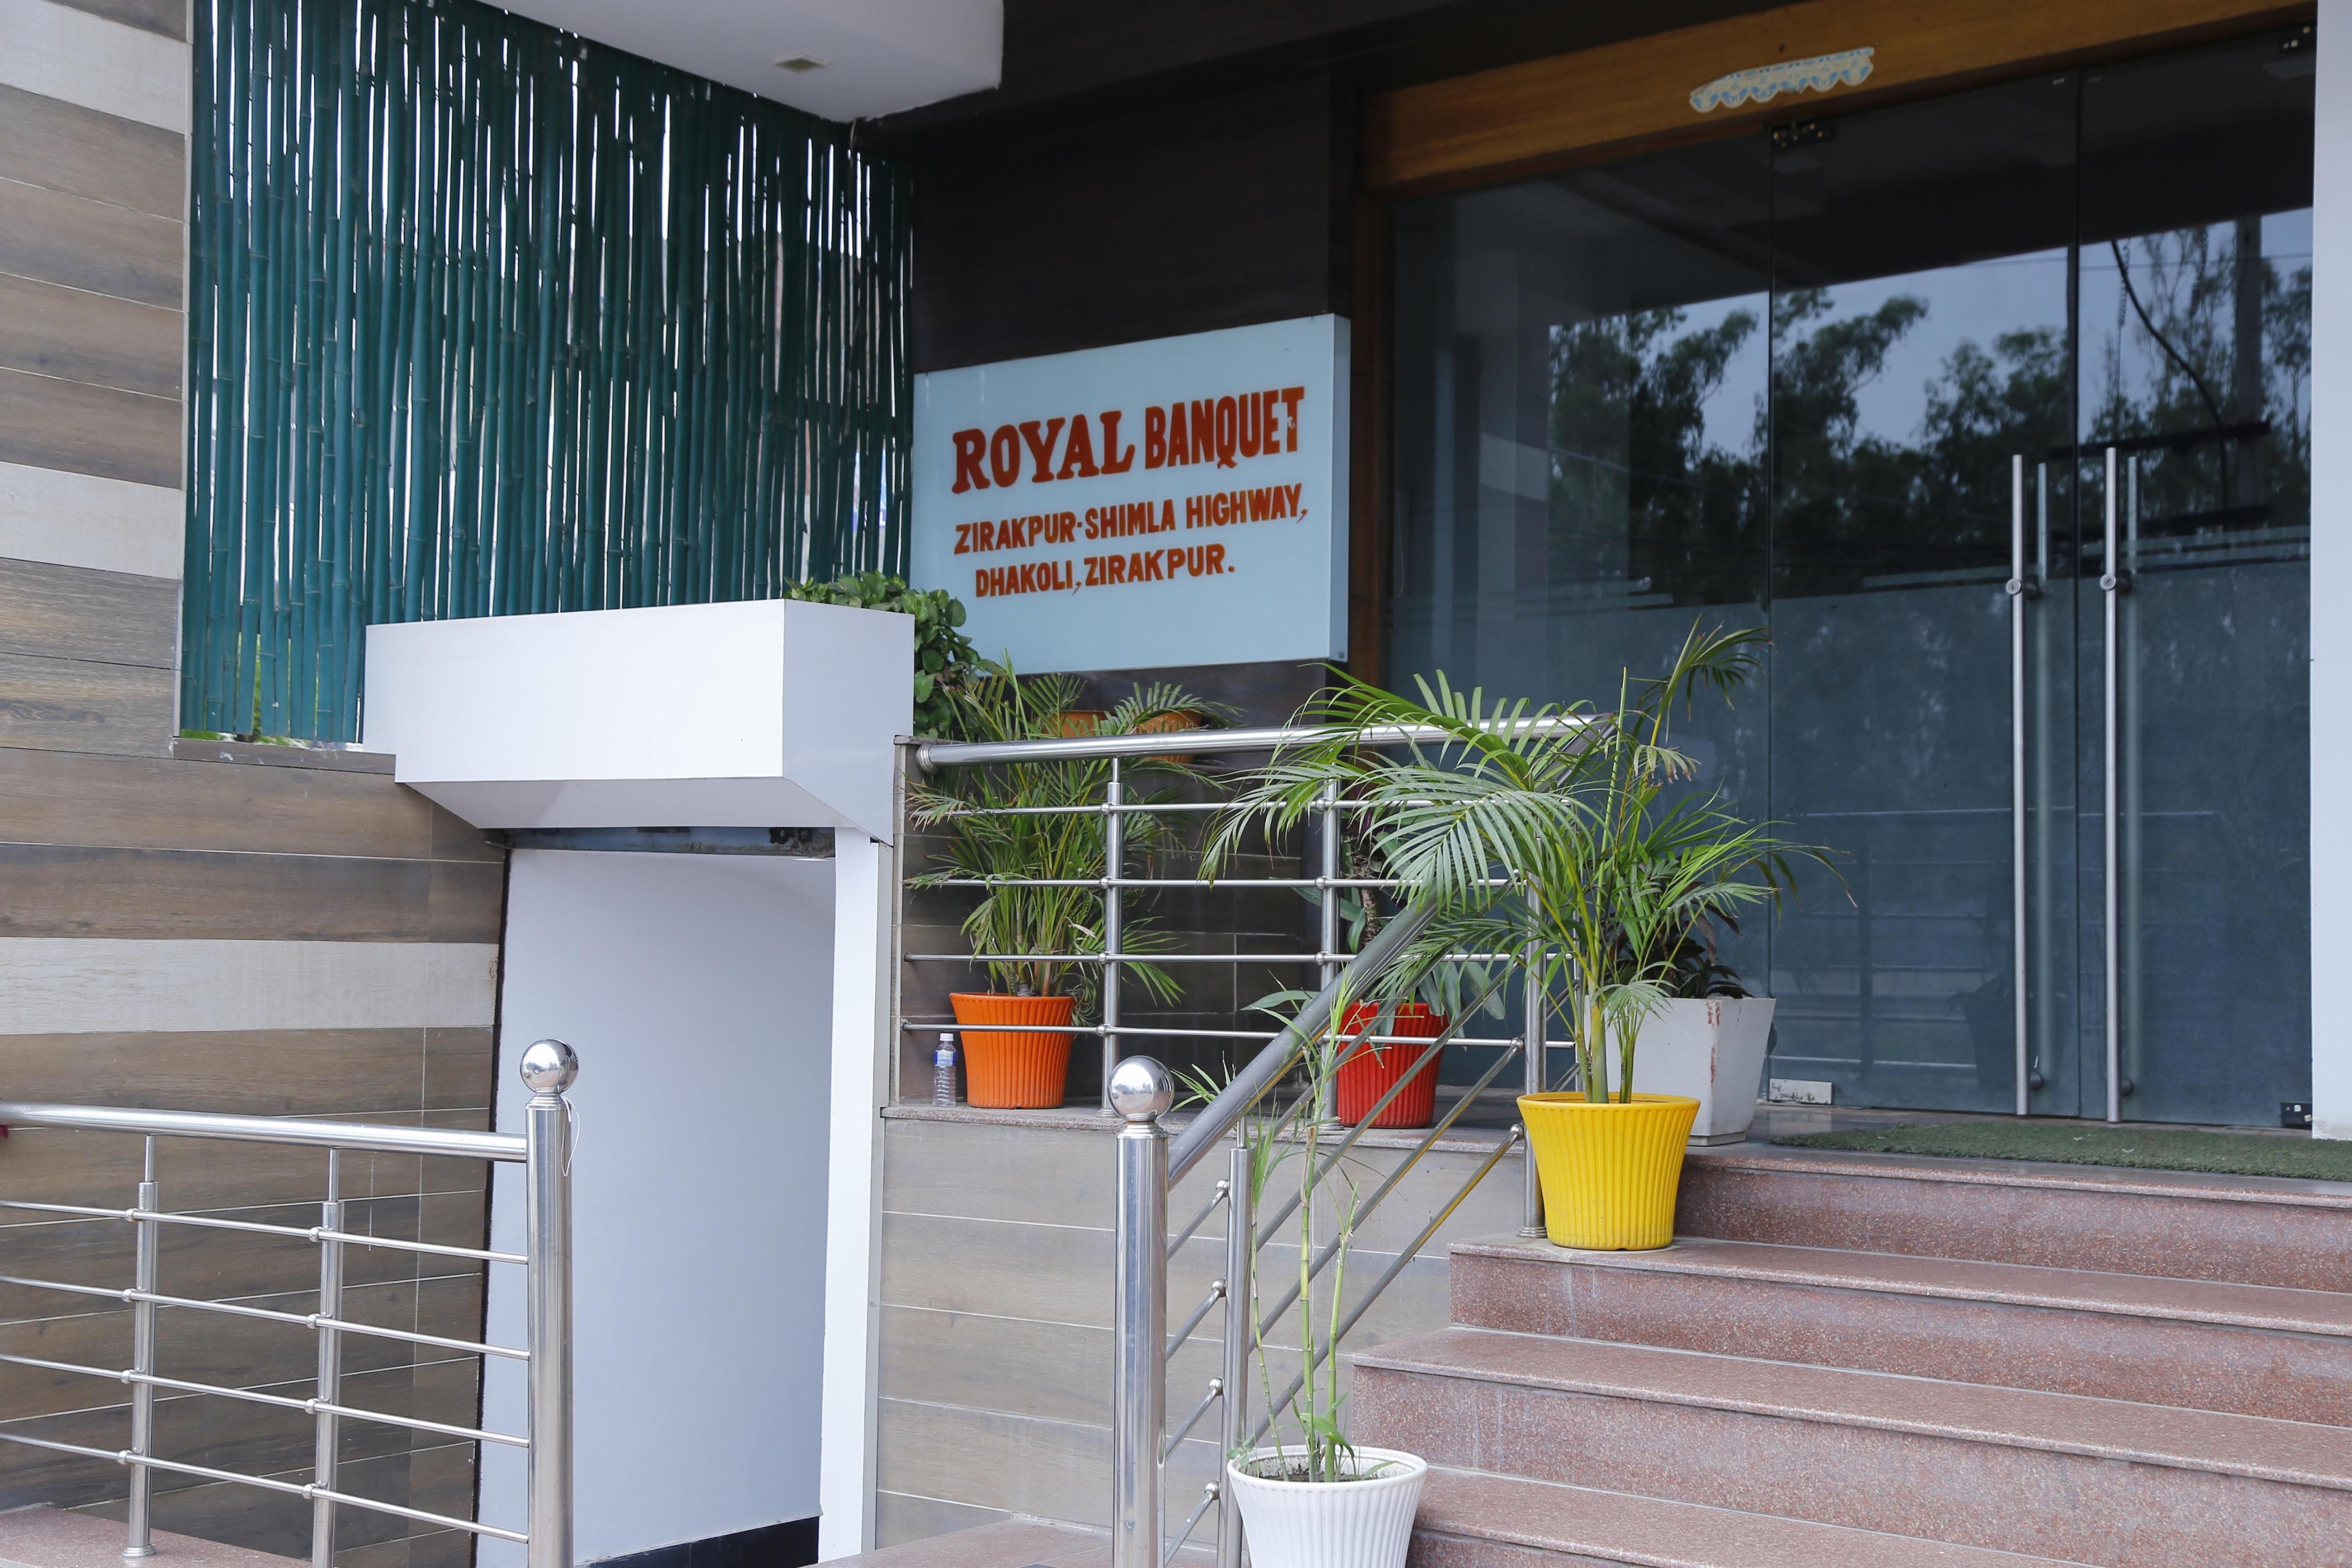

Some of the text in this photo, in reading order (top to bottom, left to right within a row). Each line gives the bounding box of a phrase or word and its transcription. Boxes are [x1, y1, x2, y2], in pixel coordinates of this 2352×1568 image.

[952, 386, 1305, 494] ROYAL BANQUET
[1185, 483, 1308, 529] HIGHWAY,
